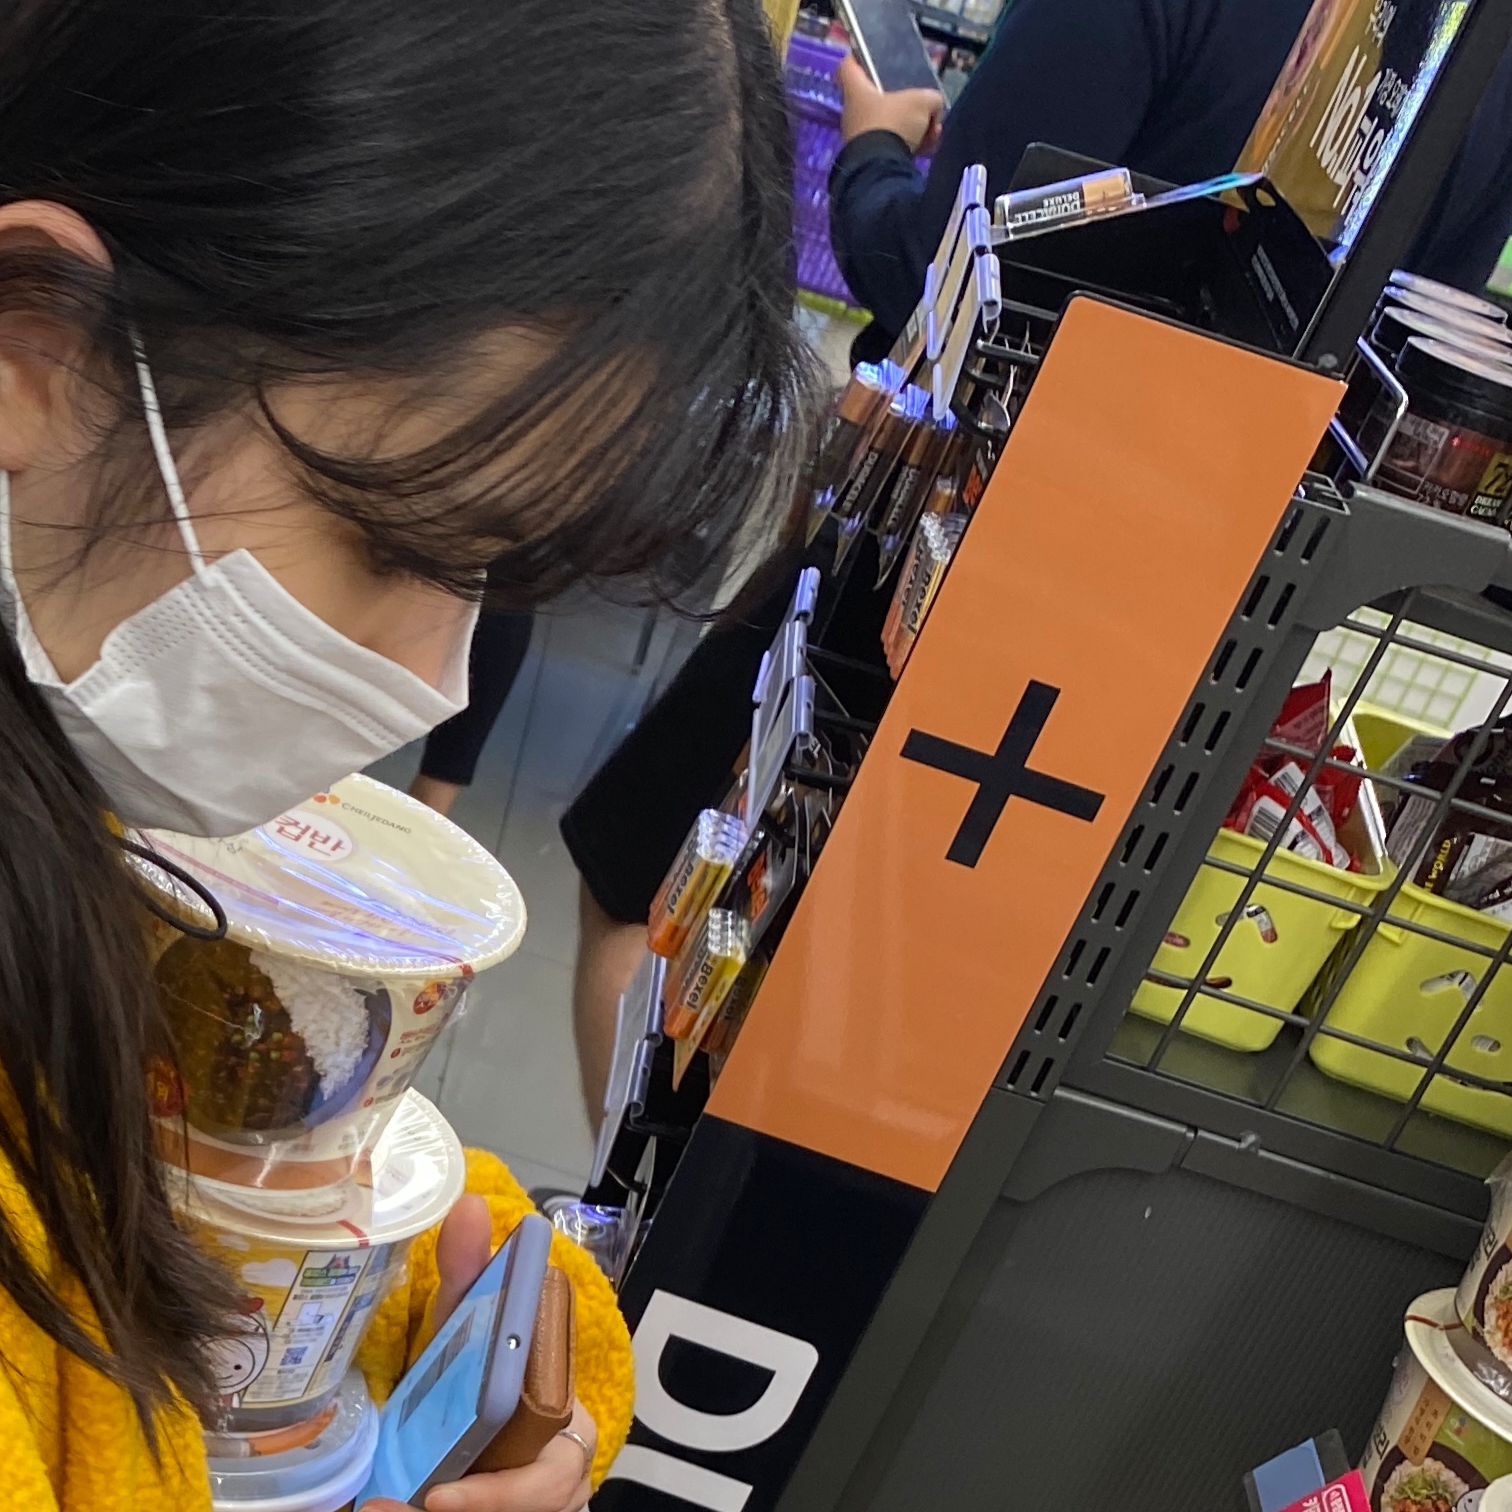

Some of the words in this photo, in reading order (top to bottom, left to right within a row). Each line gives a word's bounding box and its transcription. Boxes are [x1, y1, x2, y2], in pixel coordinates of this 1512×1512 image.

[274, 813, 345, 857] 컵반
[341, 802, 411, 835] CHEILJEDANG
[687, 959, 715, 1010] Bexel
